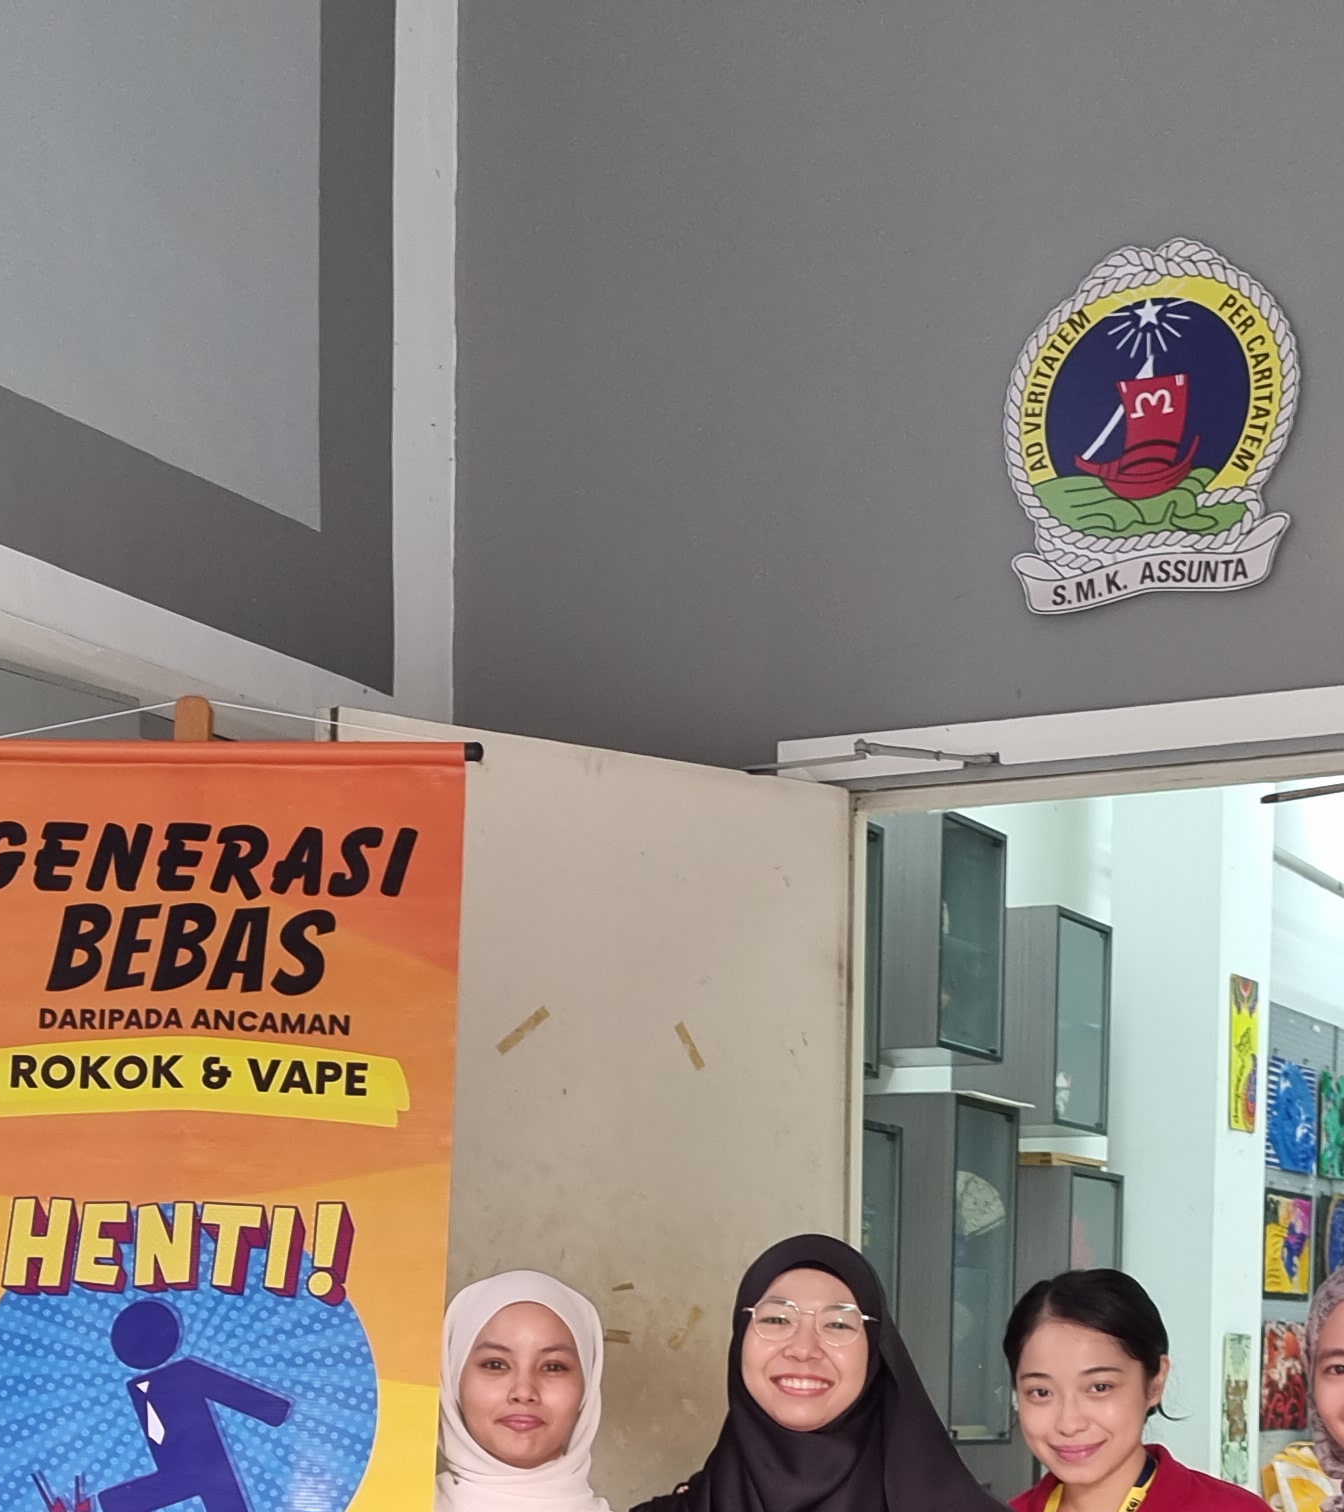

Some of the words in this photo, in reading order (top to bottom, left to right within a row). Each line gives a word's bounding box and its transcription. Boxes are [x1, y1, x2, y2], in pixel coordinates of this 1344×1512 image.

[1218, 294, 1249, 336] PER
[1024, 308, 1092, 434] VERITATEM
[1231, 334, 1274, 472] CARITATEM
[1024, 441, 1048, 473] AD
[1052, 571, 1127, 607] S.M.K.
[1140, 557, 1248, 585] ASSUNTA
[45, 902, 336, 996] BEBAS
[38, 1007, 183, 1030] DARIPADA
[191, 1009, 351, 1036] ANCAMAN
[9, 1053, 184, 1090] ROKOK
[201, 1056, 232, 1090] &
[246, 1058, 369, 1096] VAPE
[1, 1196, 355, 1306] HENTI!
